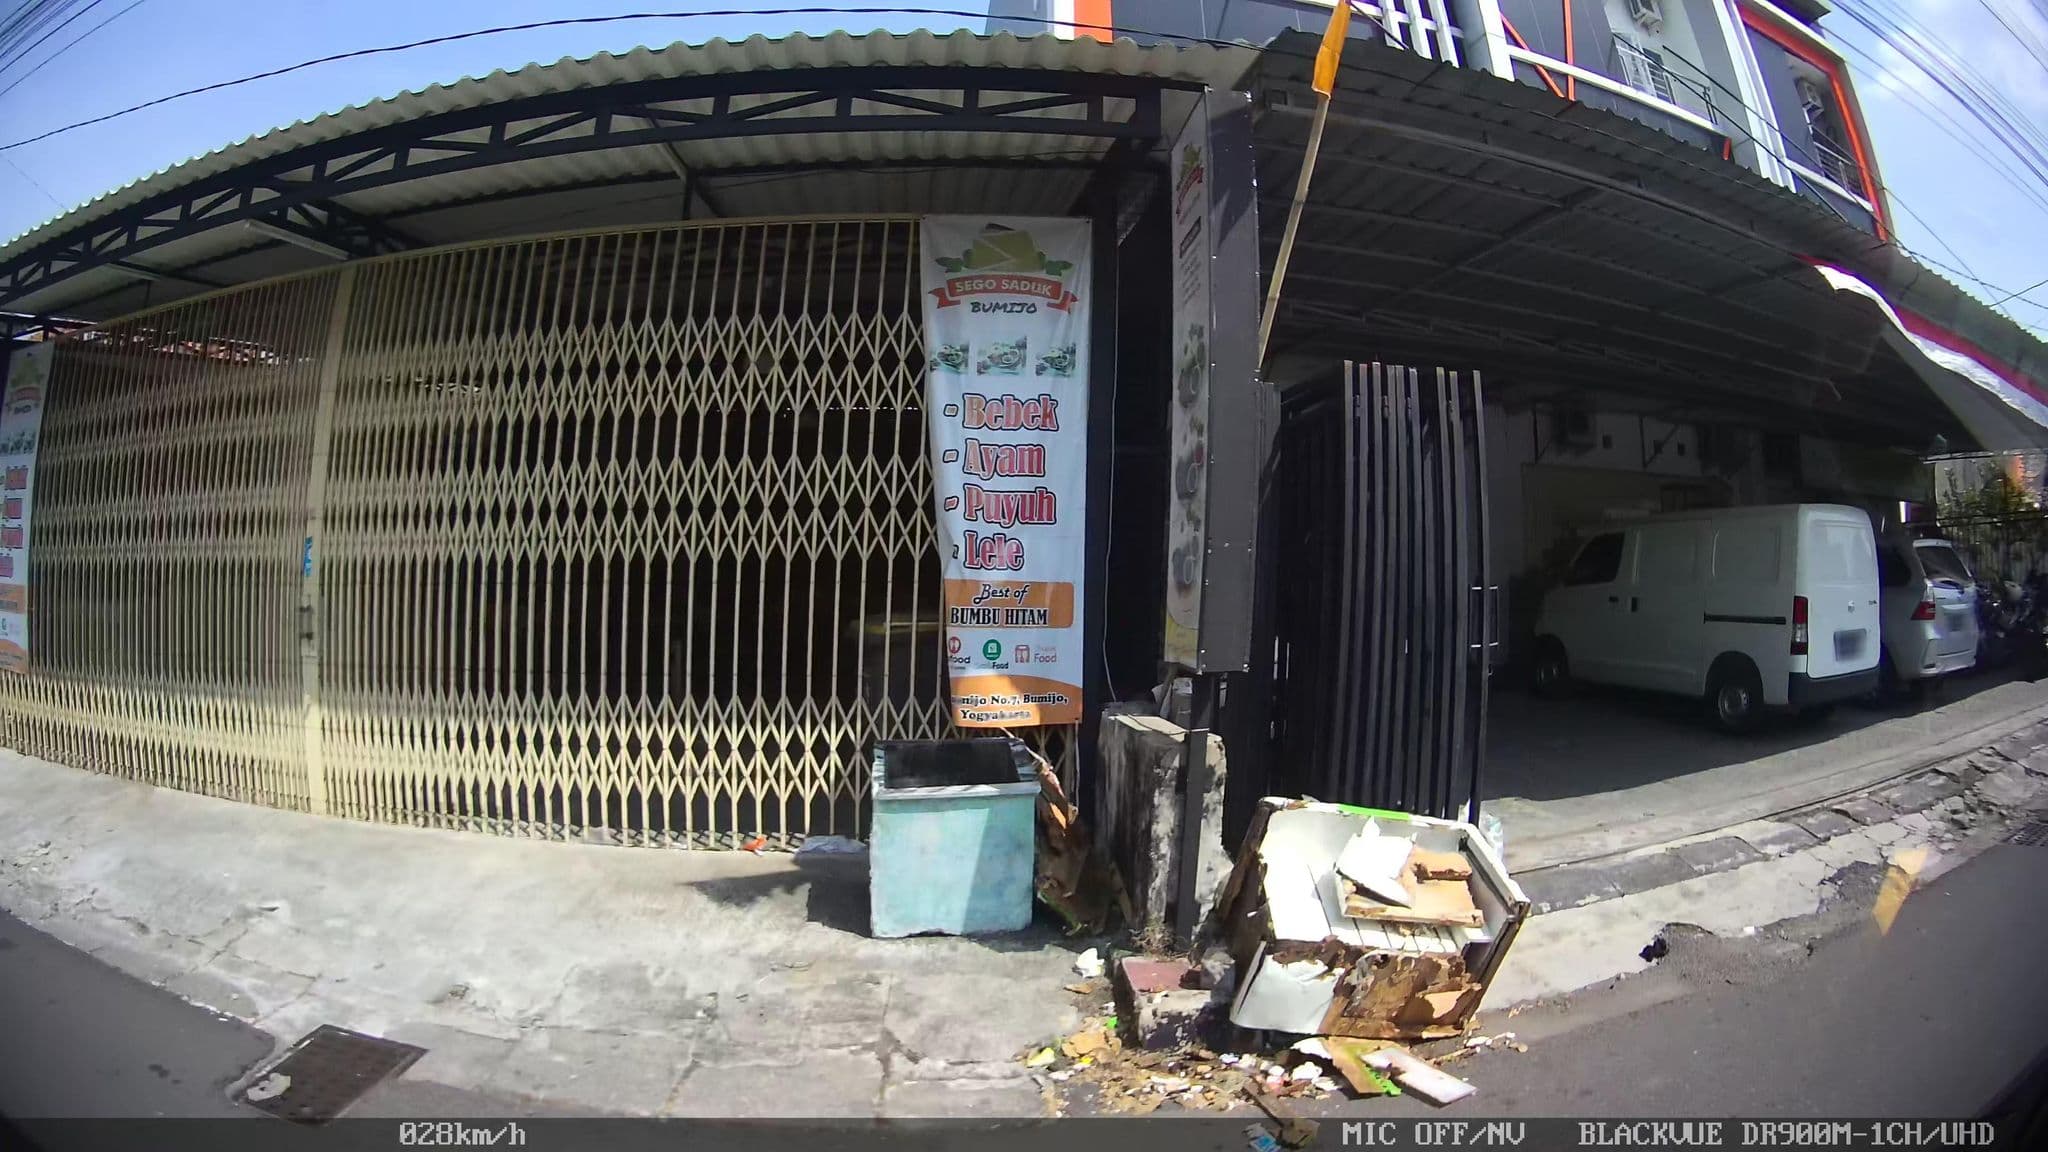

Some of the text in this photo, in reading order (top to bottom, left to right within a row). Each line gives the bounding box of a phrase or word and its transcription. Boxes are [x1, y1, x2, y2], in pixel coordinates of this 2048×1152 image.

[956, 279, 997, 292] SEGO
[970, 301, 1038, 314] BUMIJO
[962, 393, 1059, 431] Bebek
[962, 438, 1047, 480] Ayam
[963, 483, 1058, 528] Puyuh
[963, 530, 1025, 570] Lele
[973, 583, 1030, 605] Best of
[951, 607, 1049, 625] BUMBU HITAM
